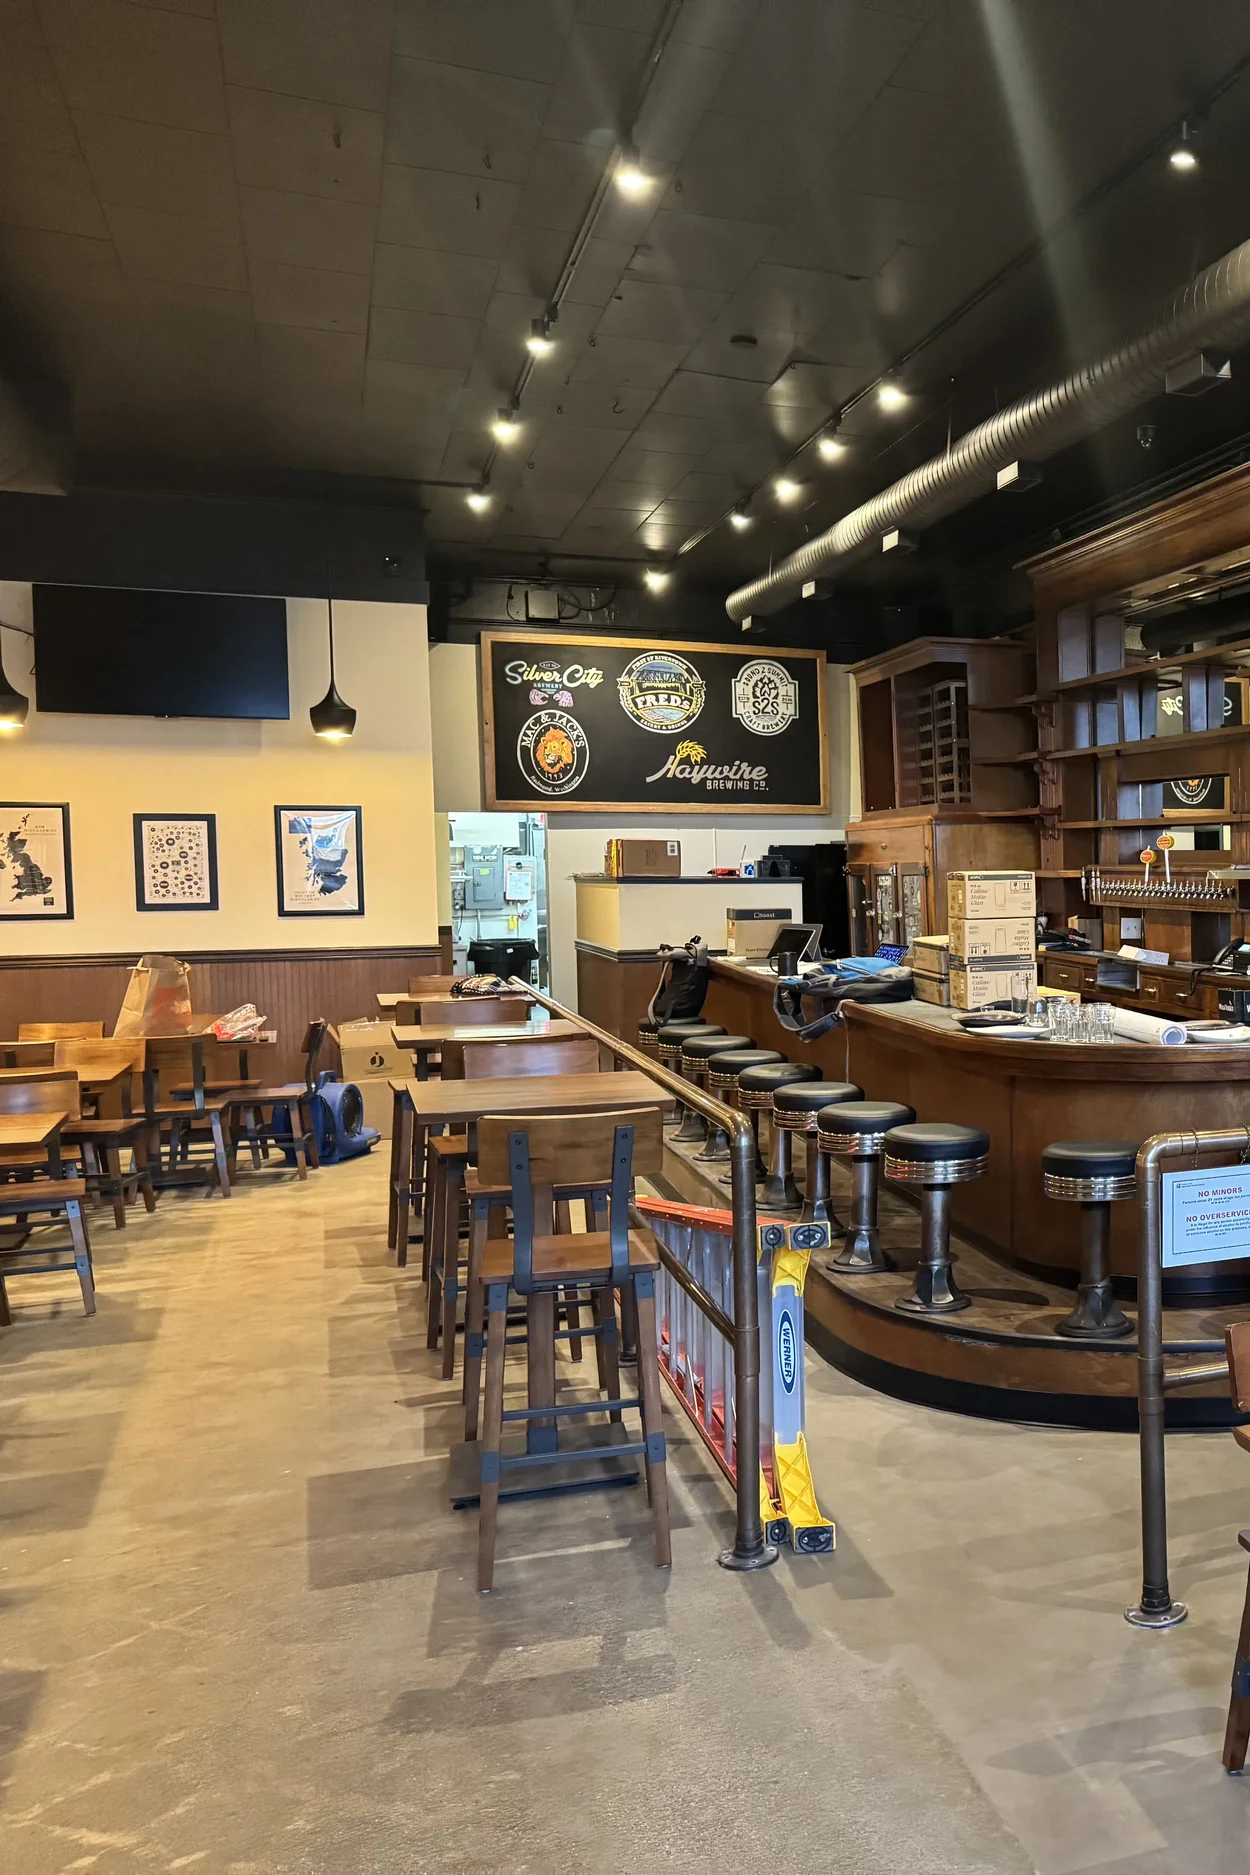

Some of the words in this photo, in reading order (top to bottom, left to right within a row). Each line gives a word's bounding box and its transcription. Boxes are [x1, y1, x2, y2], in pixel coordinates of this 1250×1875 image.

[655, 656, 688, 670] RIVERTOWN
[505, 661, 562, 685] Silver
[563, 664, 603, 688] City
[743, 668, 760, 686] SOUND
[767, 668, 787, 687] SUMMIT
[753, 698, 779, 715] S2S
[744, 711, 760, 728] CRAFT
[762, 712, 787, 730] BREWERY
[521, 720, 539, 748] MAC
[541, 713, 551, 723] &
[553, 713, 585, 747] JACK'S
[646, 755, 768, 784] Haywire
[706, 780, 749, 790] BREWING
[1212, 1187, 1242, 1196] MINORS
[783, 1328, 791, 1378] WERNER
